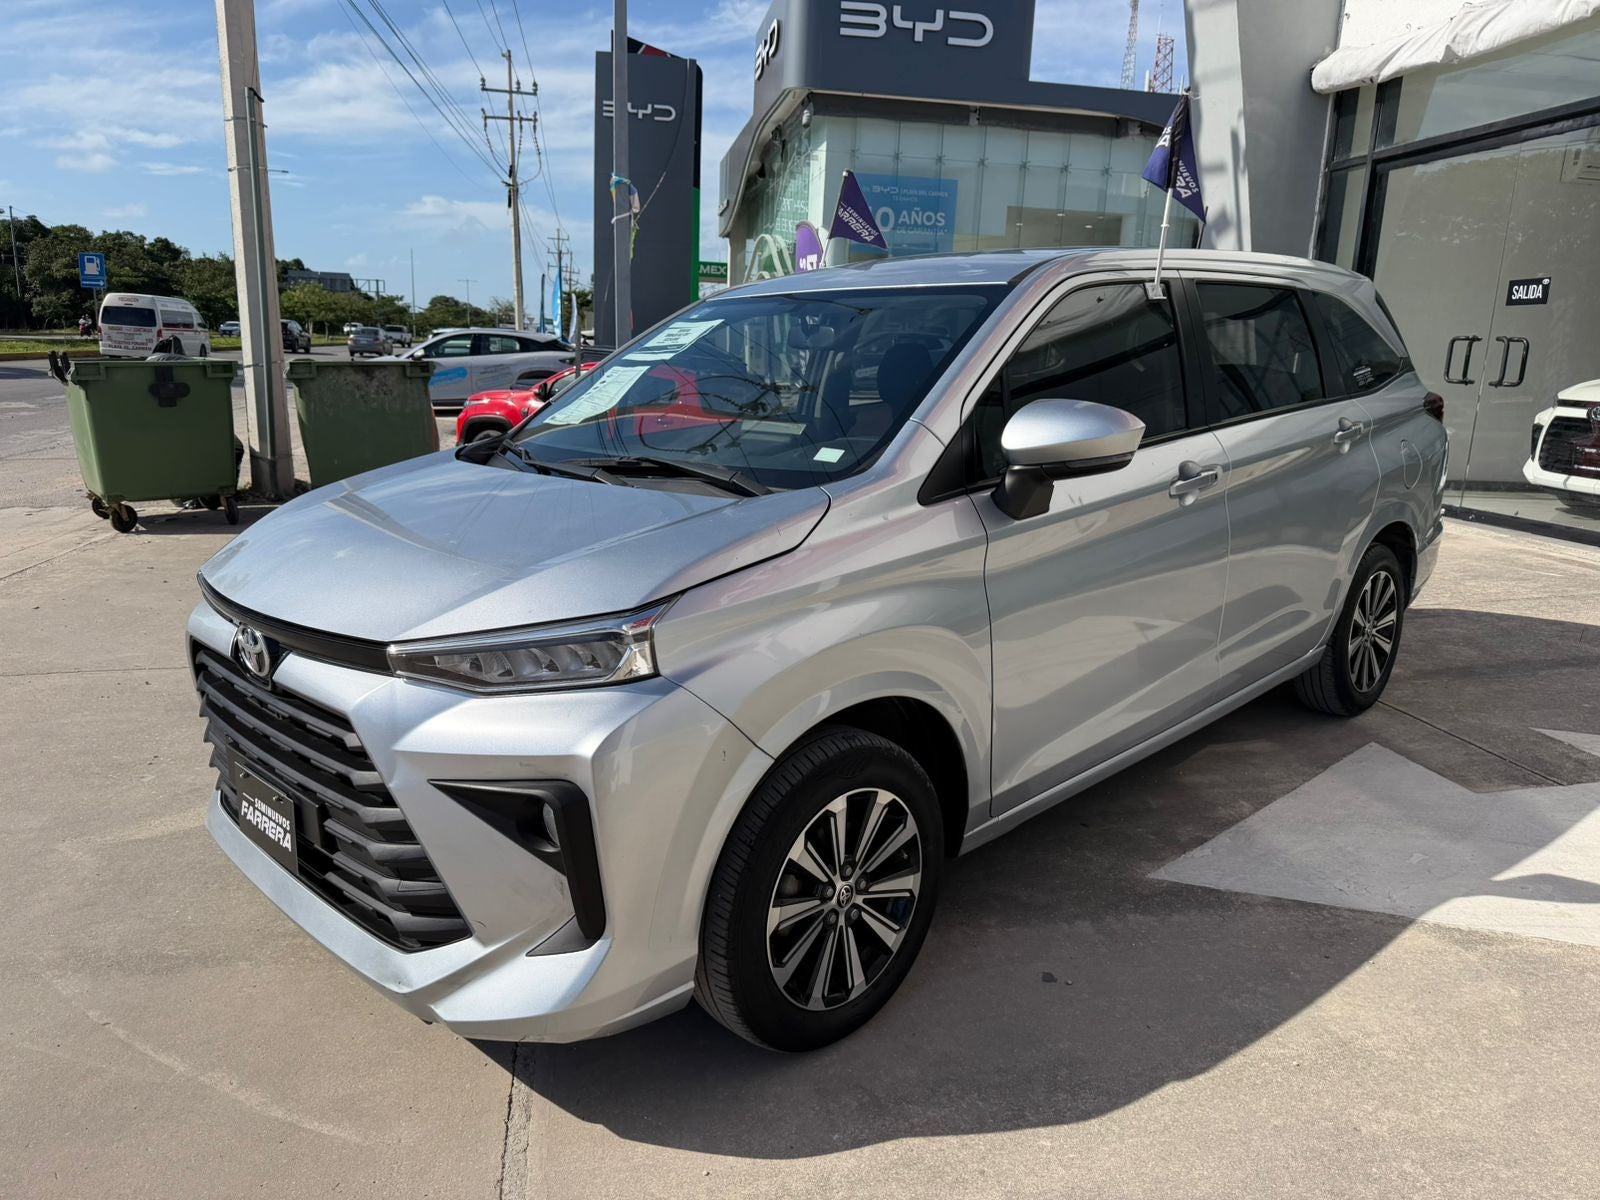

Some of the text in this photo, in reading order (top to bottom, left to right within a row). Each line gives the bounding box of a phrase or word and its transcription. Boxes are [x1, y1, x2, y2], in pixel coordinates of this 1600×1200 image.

[840, 0, 994, 47] BYD
[755, 18, 780, 80] BYD
[838, 205, 875, 242] ARRERA
[897, 207, 946, 227] AÑOS
[1511, 284, 1543, 300] SALIDA
[241, 800, 292, 853] FARRERA
[254, 797, 291, 831] SEMINUEVOS
